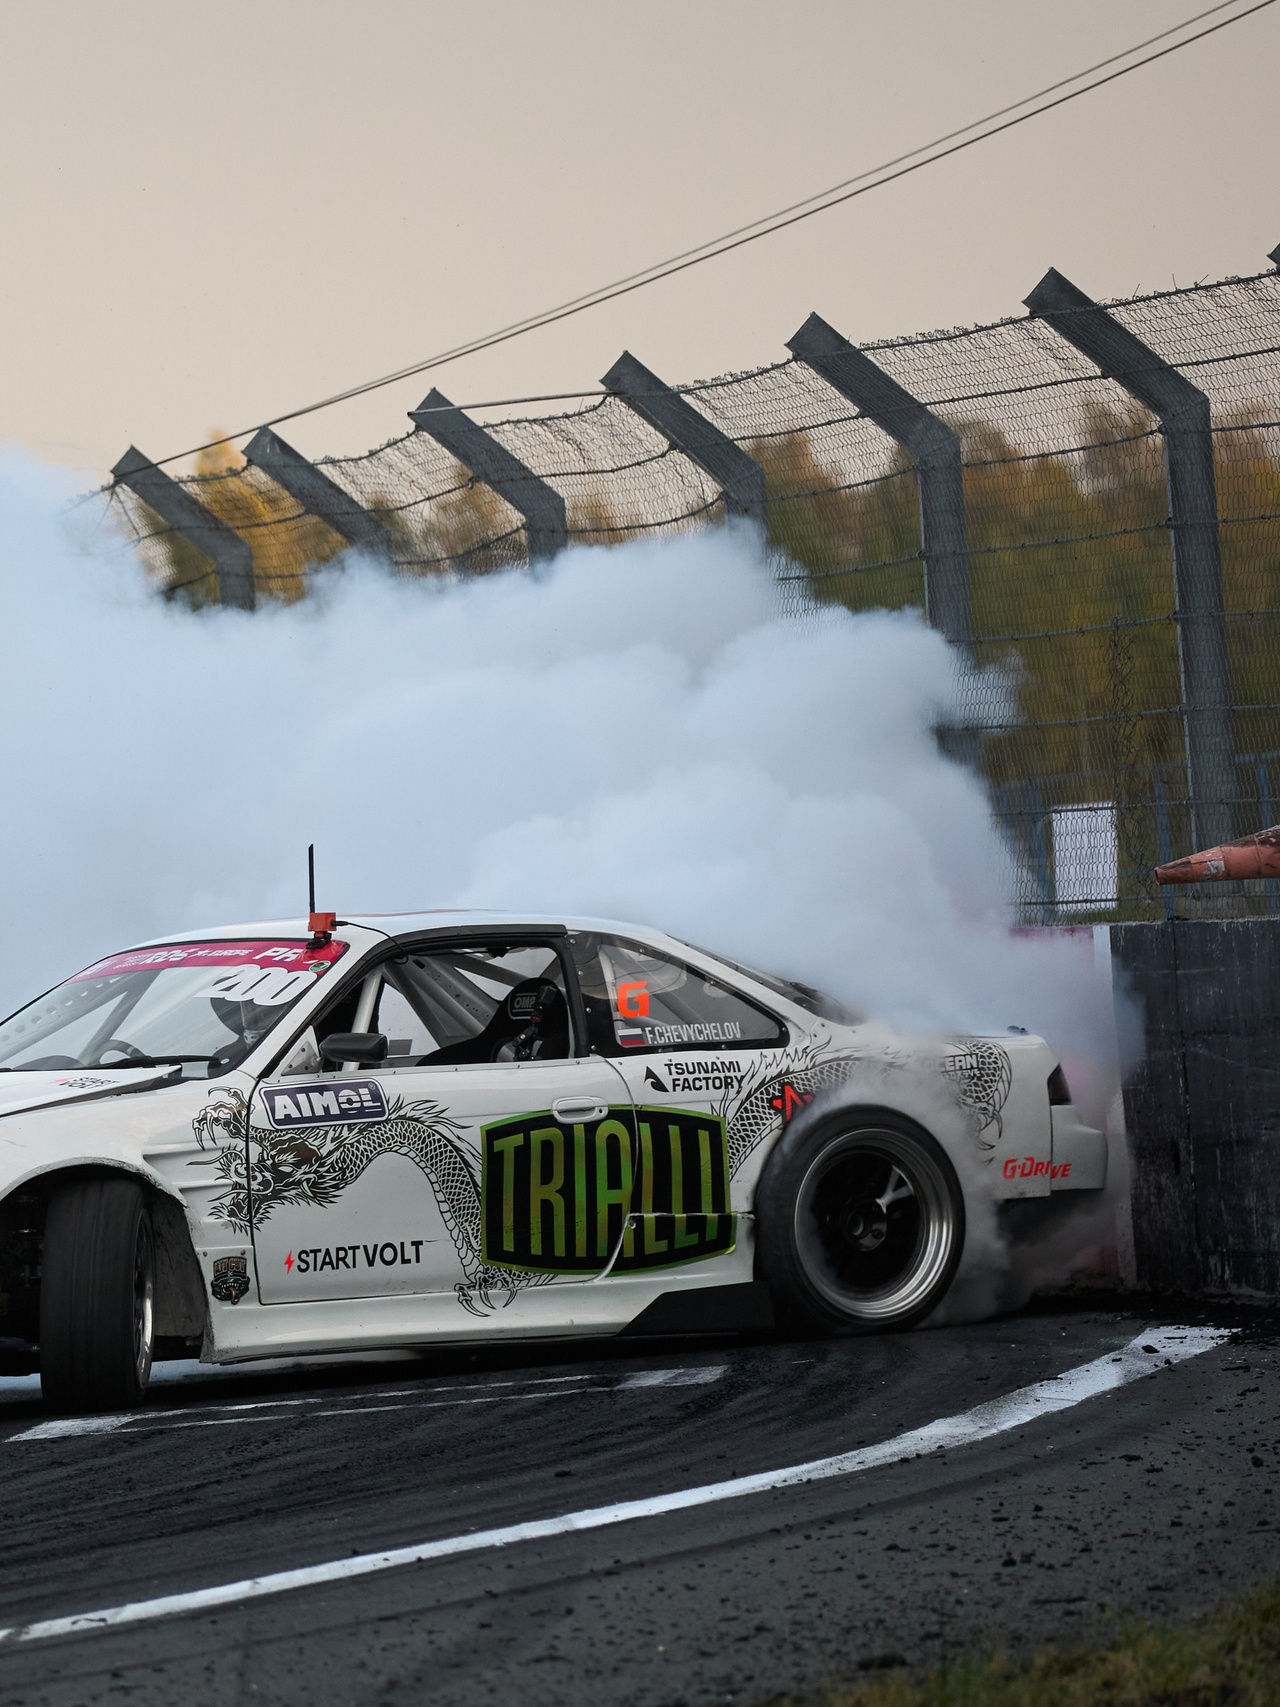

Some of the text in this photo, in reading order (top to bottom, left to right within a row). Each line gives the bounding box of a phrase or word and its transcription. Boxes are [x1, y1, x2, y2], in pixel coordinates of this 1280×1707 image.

[193, 964, 317, 1006] 200
[514, 996, 536, 1009] OMP
[645, 1022, 741, 1045] F.CHEVYCHELOV
[664, 1060, 741, 1076] TSUNAMI
[672, 1075, 745, 1092] FACTORY
[274, 1087, 383, 1120] AIMOL
[493, 1118, 719, 1259] TRIALLI
